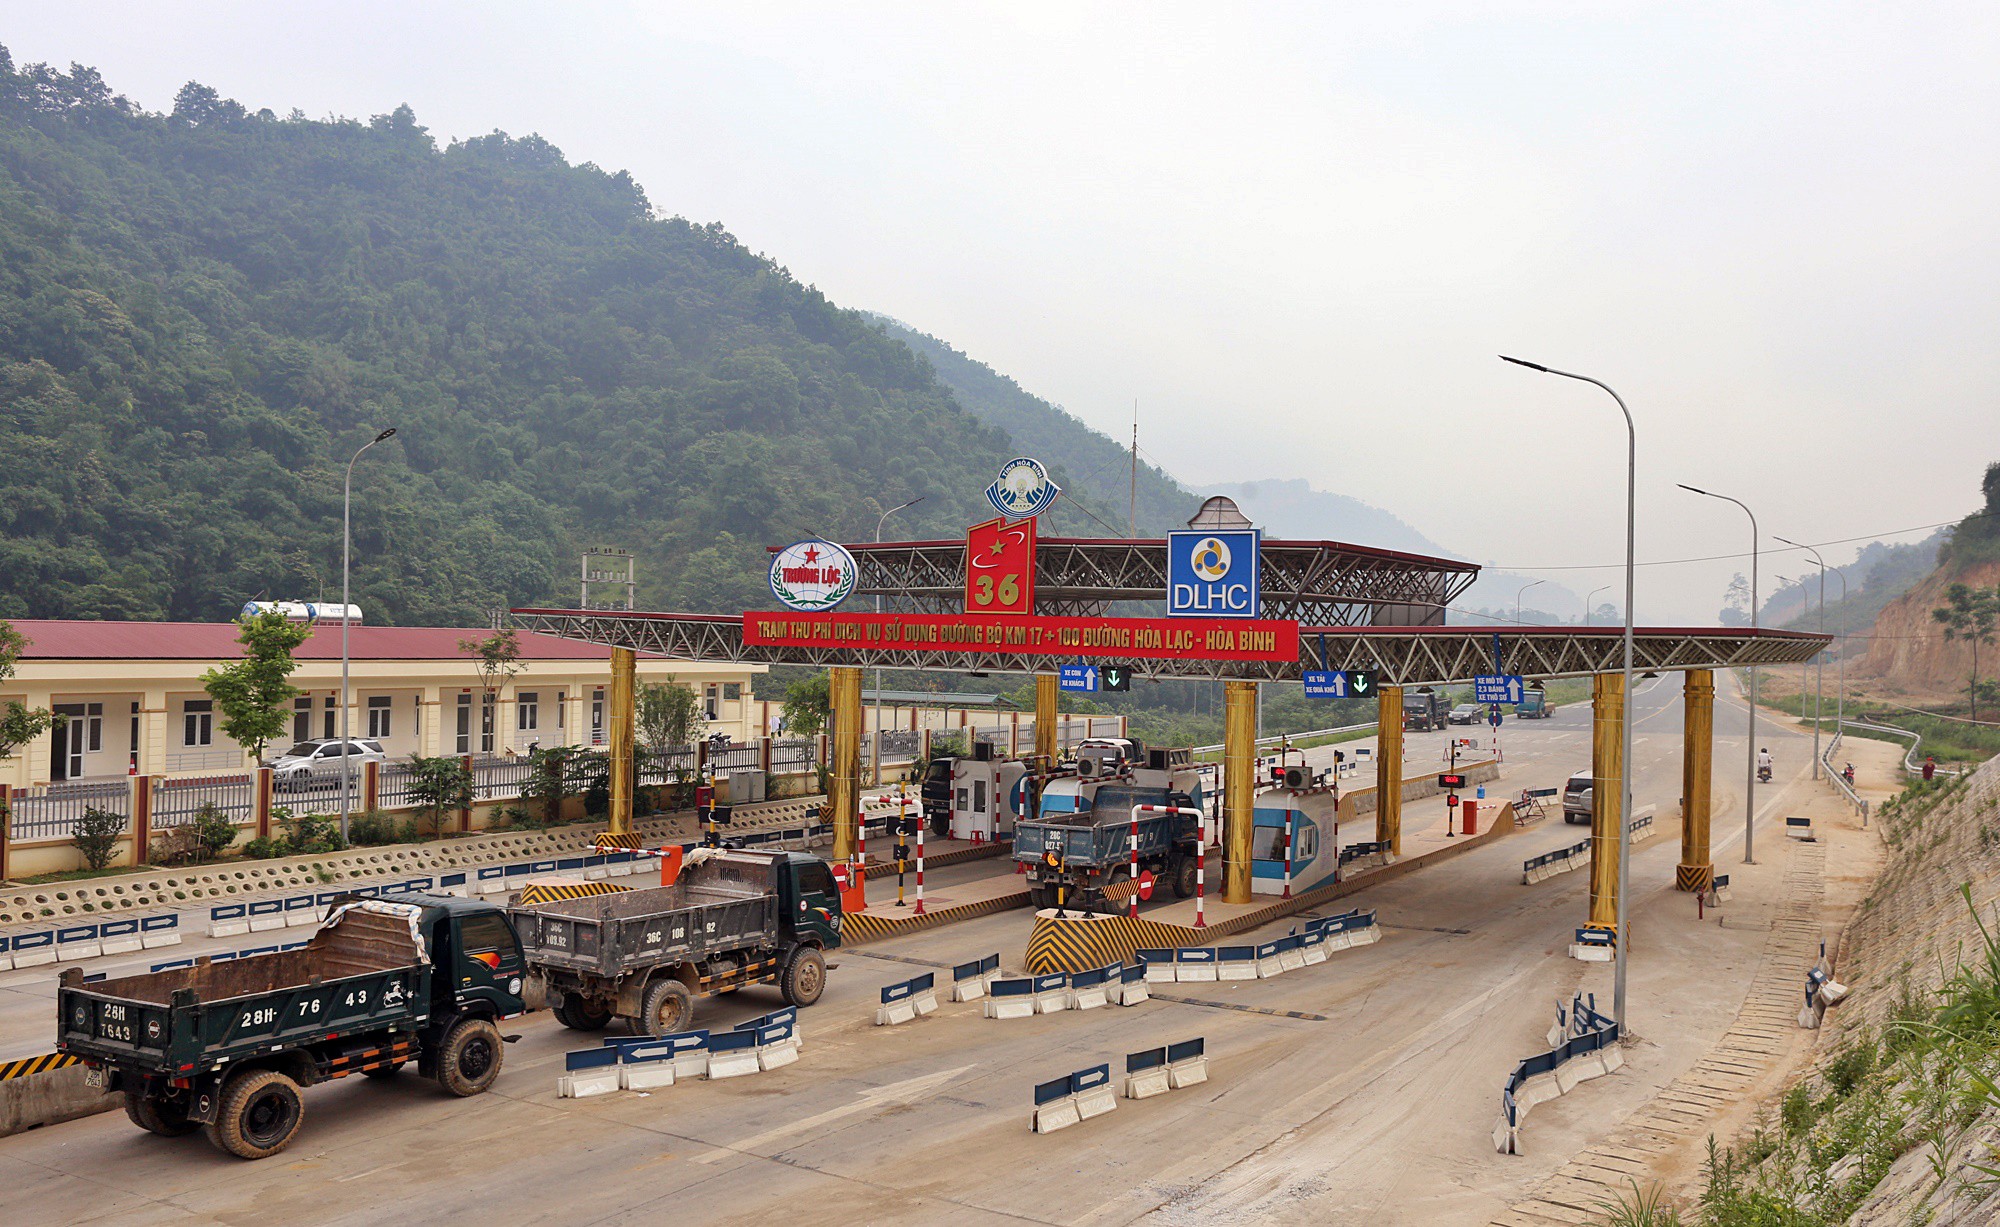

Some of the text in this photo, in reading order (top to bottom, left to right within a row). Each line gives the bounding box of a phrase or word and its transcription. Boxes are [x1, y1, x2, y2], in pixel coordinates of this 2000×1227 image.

[782, 563, 841, 588] TRƯỜNG LỘC
[974, 573, 1019, 606] 36
[1174, 583, 1248, 610] DLHC
[757, 620, 788, 642] TRẠM
[789, 621, 811, 639] THU
[813, 616, 833, 640] PHÍ
[834, 622, 861, 645] DỊCH
[866, 623, 882, 645] VỤ
[884, 617, 902, 642] SỬ
[904, 624, 937, 647] DỤNG
[940, 620, 984, 644] ĐƯỜNG
[985, 621, 1003, 648] BỘ
[1005, 625, 1027, 645] KM
[1083, 623, 1130, 648] ĐƯỜNG
[1134, 625, 1162, 649] HÒA
[1165, 629, 1193, 653] LẠC
[1205, 626, 1235, 651] HÒA
[1239, 627, 1276, 652] BÌNH
[646, 922, 716, 944] 36C 108 92
[104, 1003, 126, 1021] 28H
[299, 999, 321, 1017] 76
[345, 990, 367, 1007] 43
[101, 1023, 131, 1041] 7643
